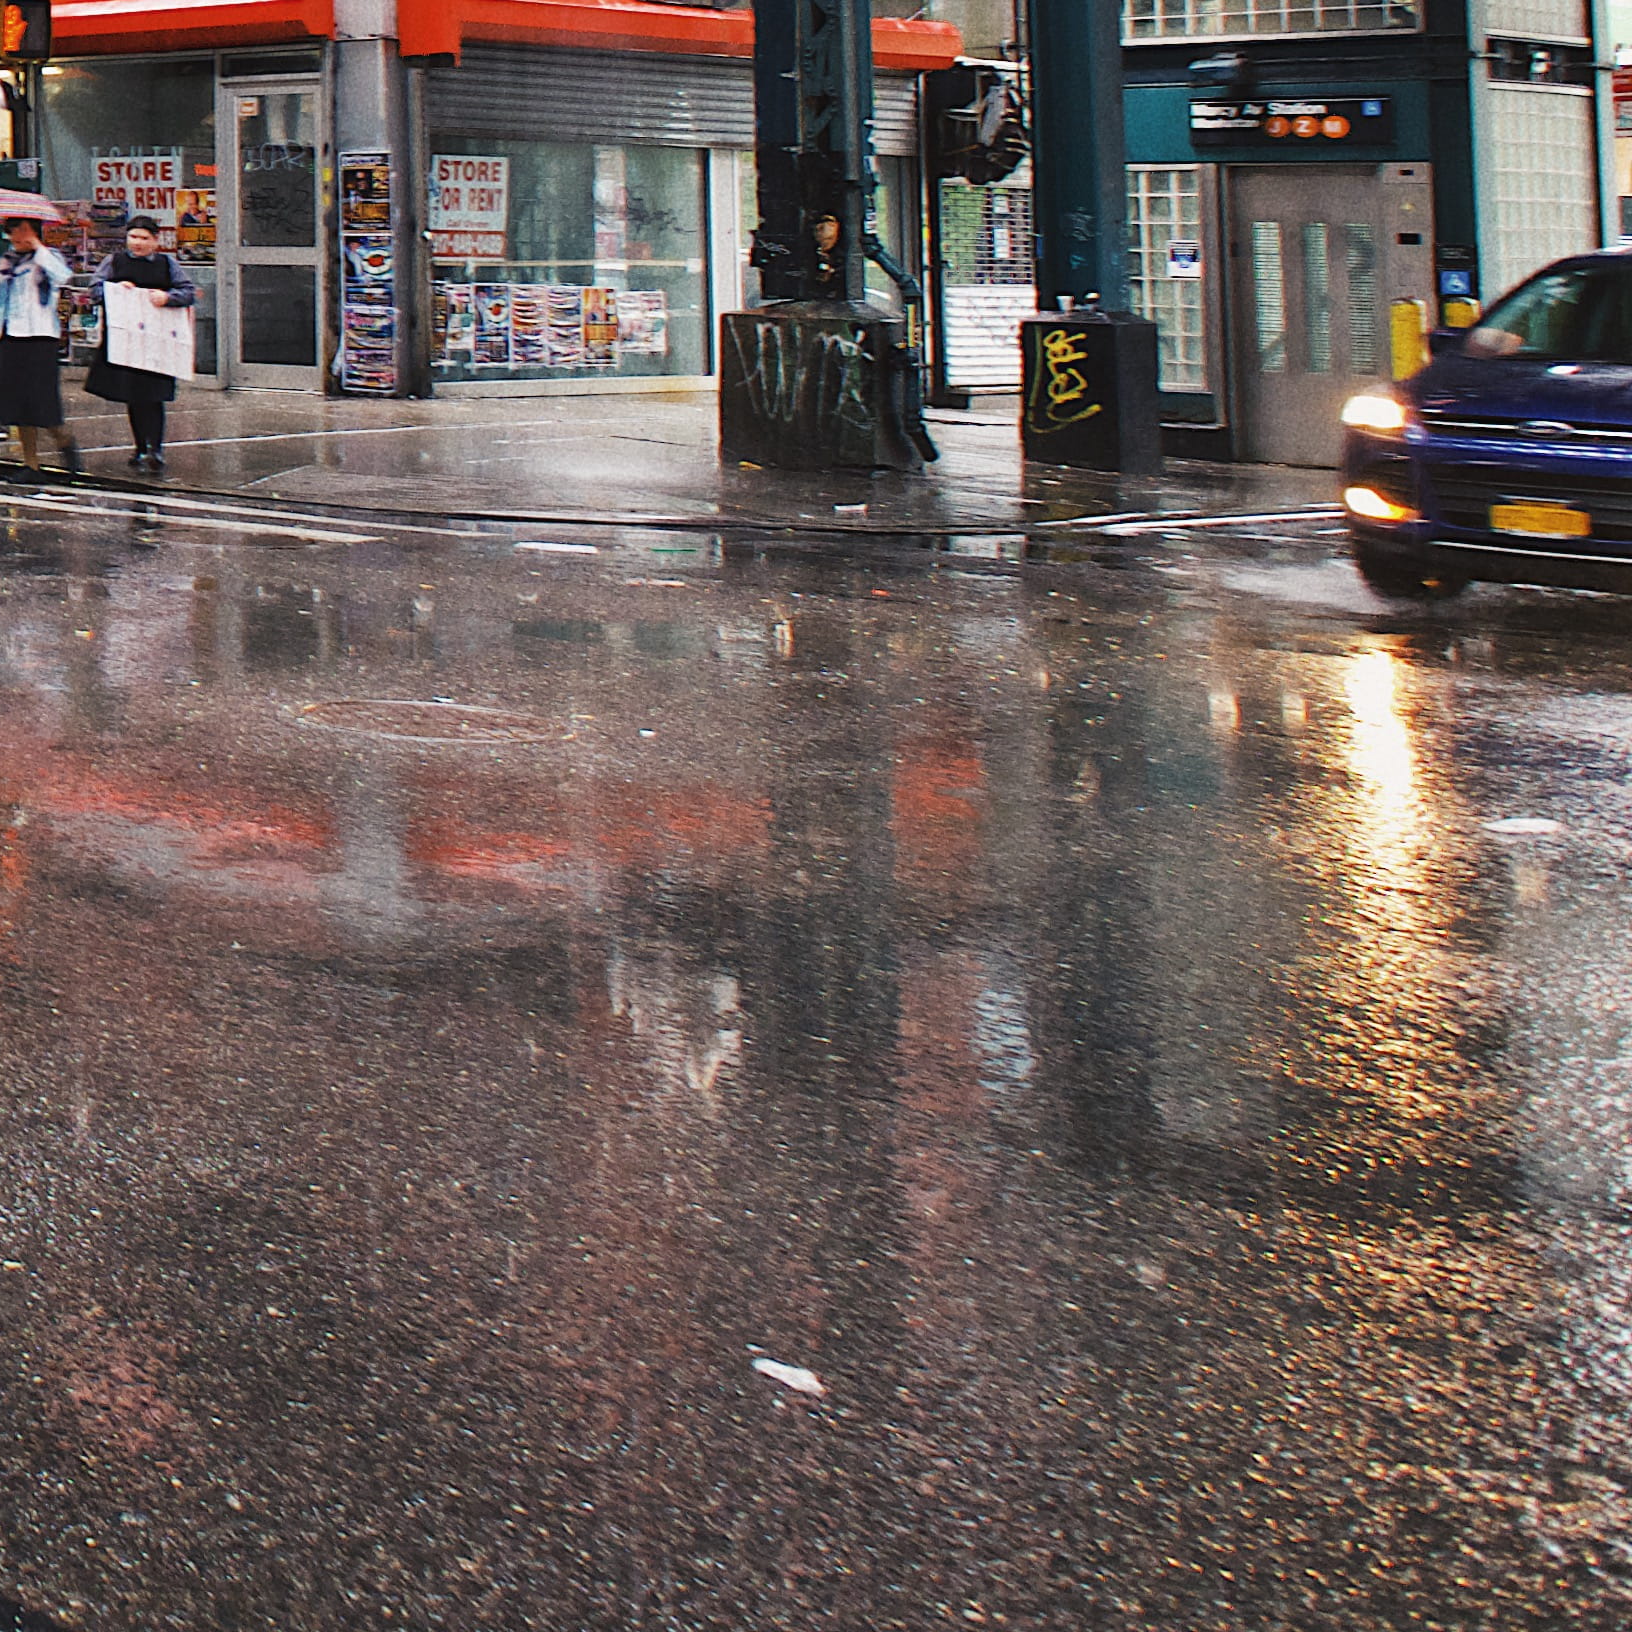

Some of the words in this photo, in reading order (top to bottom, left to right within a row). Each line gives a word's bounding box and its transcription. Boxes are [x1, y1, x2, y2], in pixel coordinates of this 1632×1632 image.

[97, 161, 174, 182] STORE
[439, 160, 503, 183] STORE
[134, 186, 176, 210] RENT
[441, 186, 462, 212] OR
